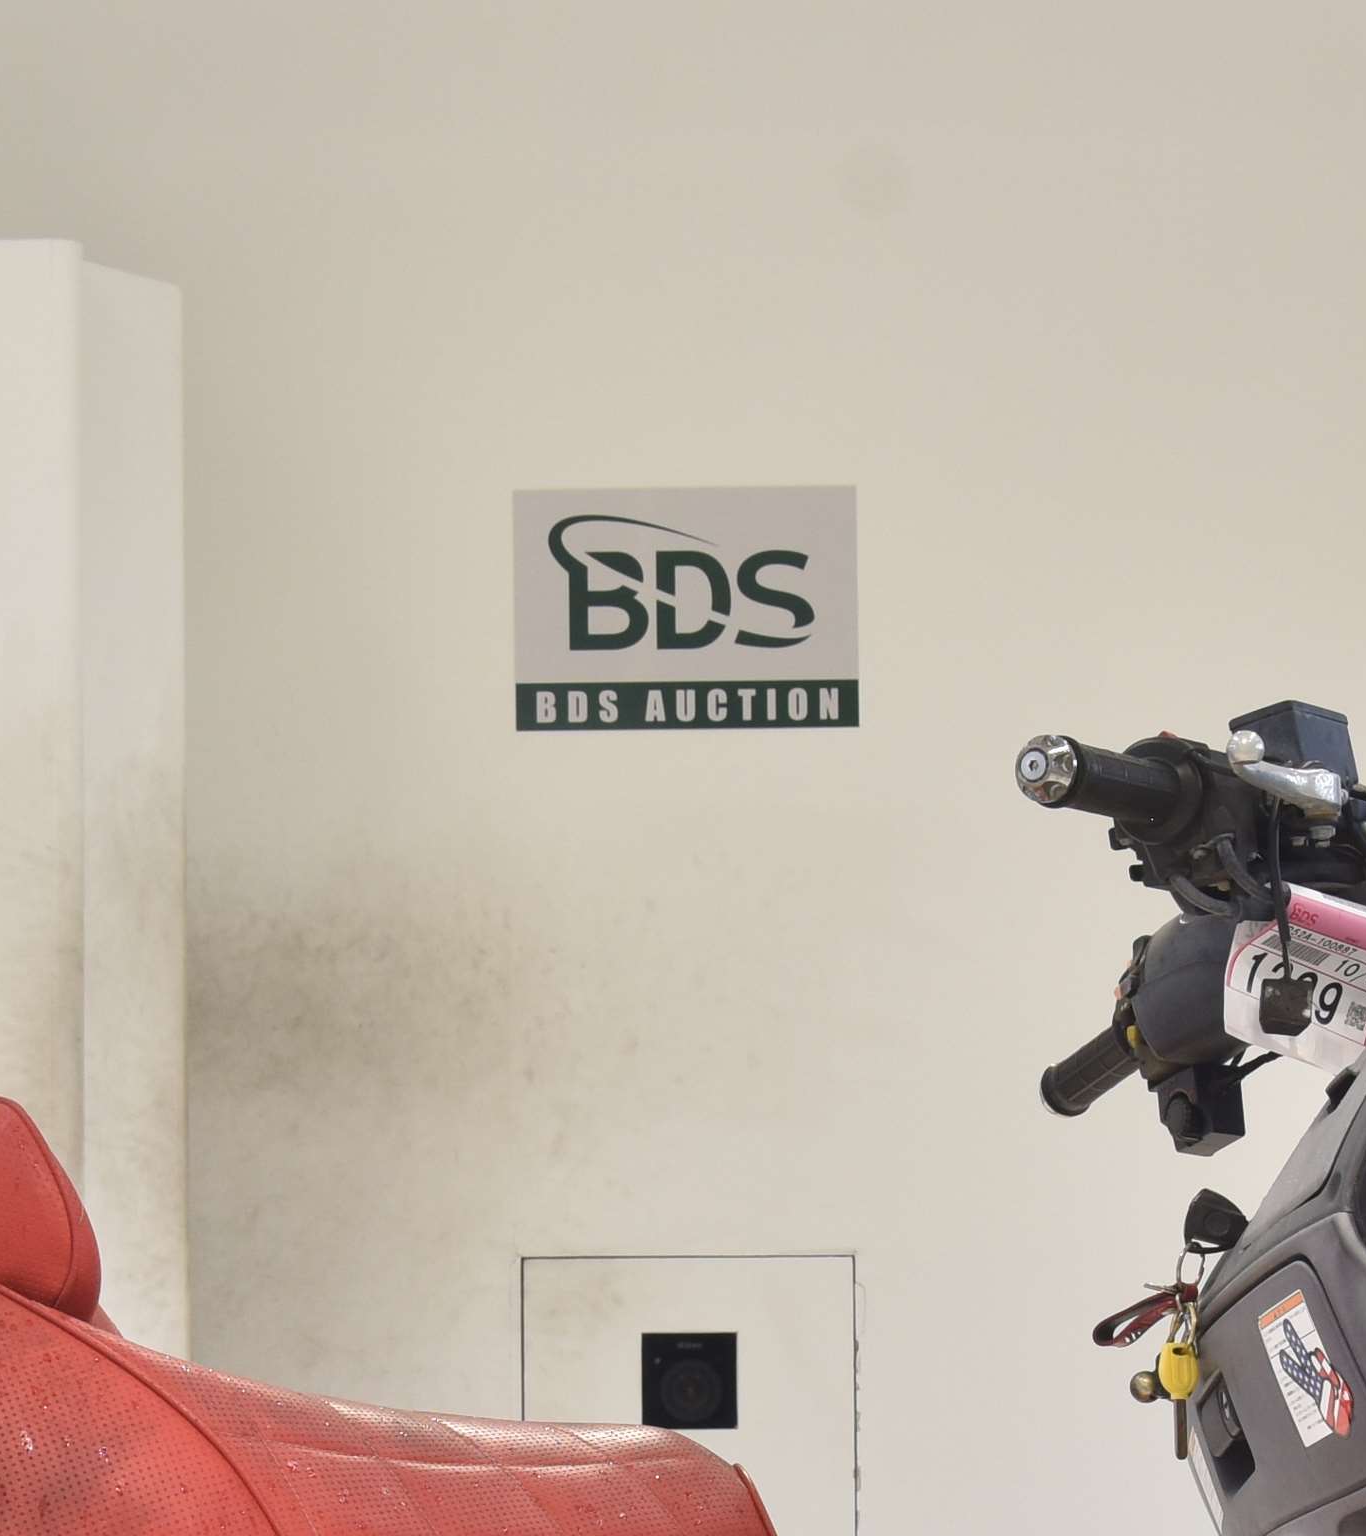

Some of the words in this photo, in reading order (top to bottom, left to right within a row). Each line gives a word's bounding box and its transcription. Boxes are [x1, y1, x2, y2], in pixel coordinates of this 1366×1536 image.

[547, 514, 815, 650] BDS
[535, 690, 619, 723] BDS
[644, 687, 839, 722] AUCTION
[1247, 952, 1343, 1025] 19
